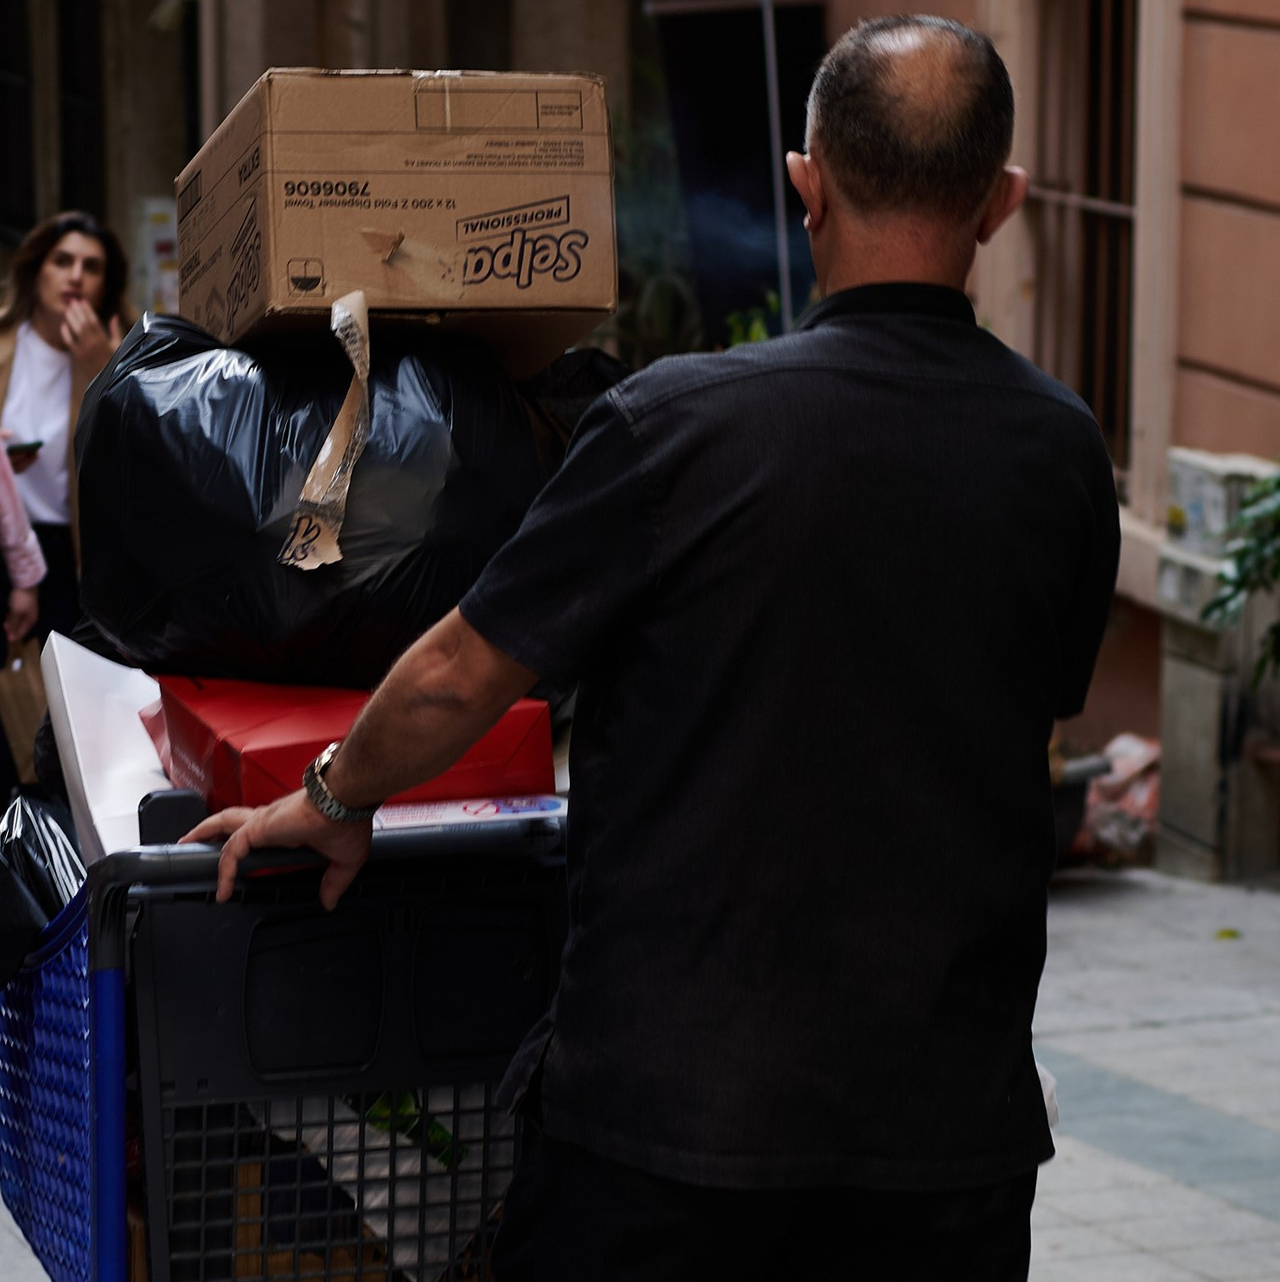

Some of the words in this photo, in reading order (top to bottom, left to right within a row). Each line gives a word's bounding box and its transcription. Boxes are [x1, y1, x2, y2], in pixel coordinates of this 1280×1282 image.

[284, 180, 371, 197] 7906606
[284, 198, 316, 210] Towel
[320, 198, 371, 210] Dispenser
[374, 198, 398, 210] Fold
[401, 198, 409, 209] Z
[411, 198, 433, 209] 200
[445, 199, 457, 210] 12
[463, 206, 562, 235] PROFESSIONAL
[463, 228, 589, 290] Selpa
